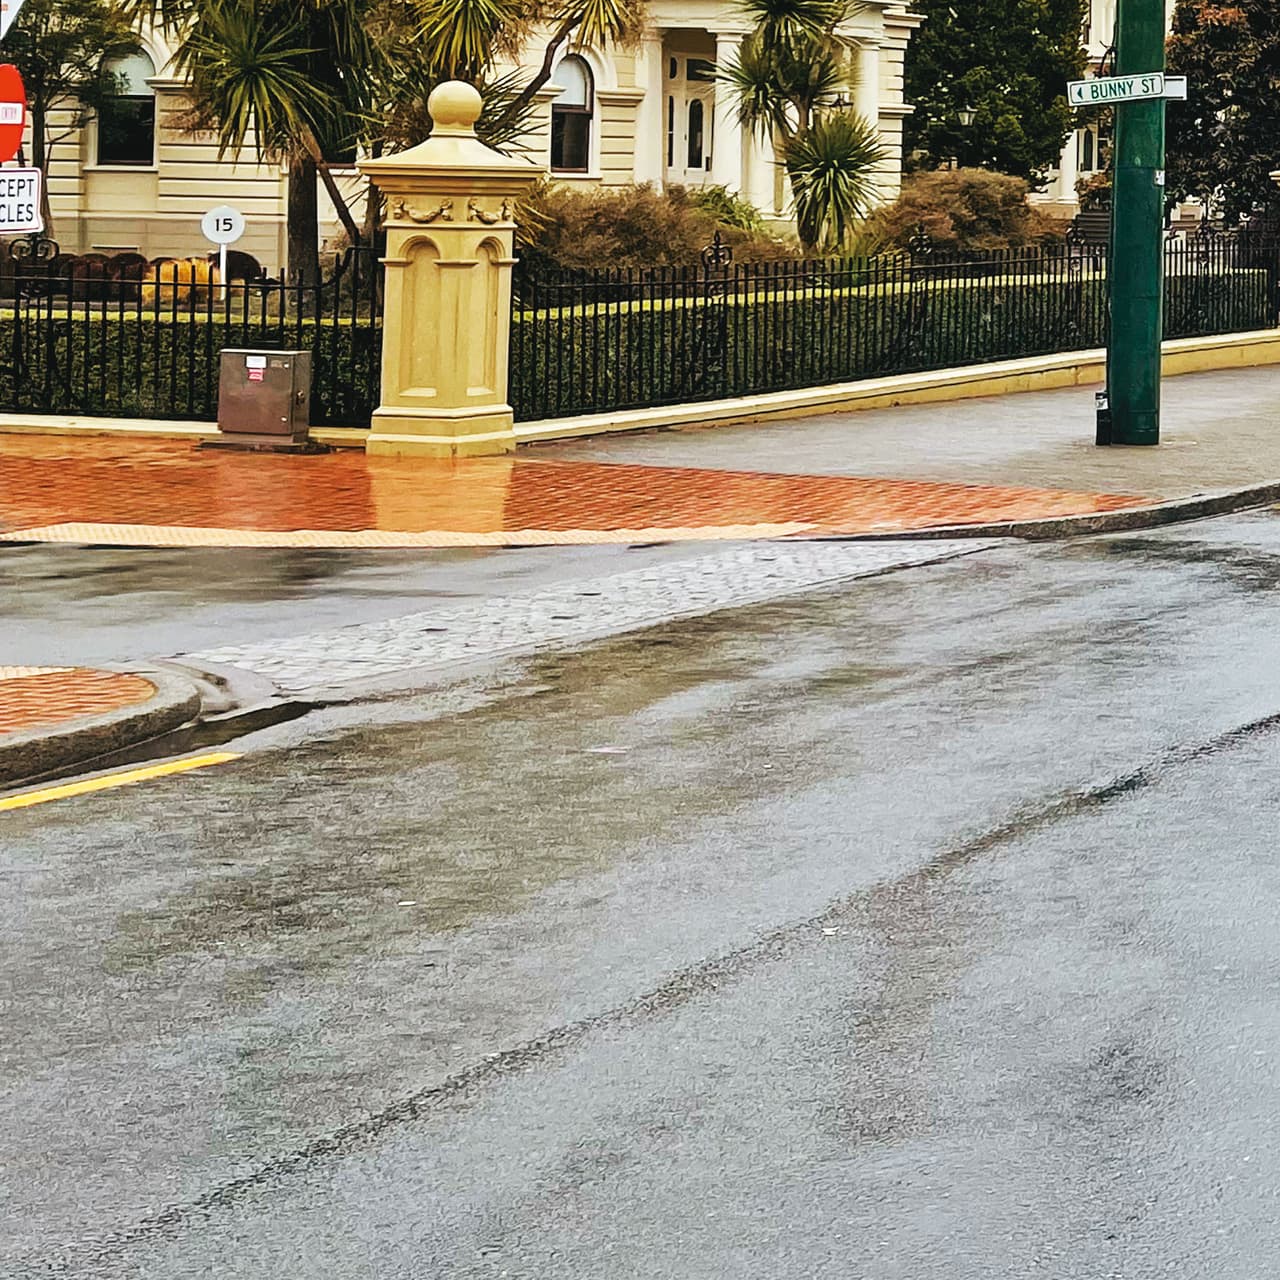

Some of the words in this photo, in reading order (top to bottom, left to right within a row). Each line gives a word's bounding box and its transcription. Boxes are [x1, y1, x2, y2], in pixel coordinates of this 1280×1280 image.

[1090, 79, 1134, 99] BUNNY
[1141, 78, 1156, 93] ST
[215, 217, 233, 232] 15
